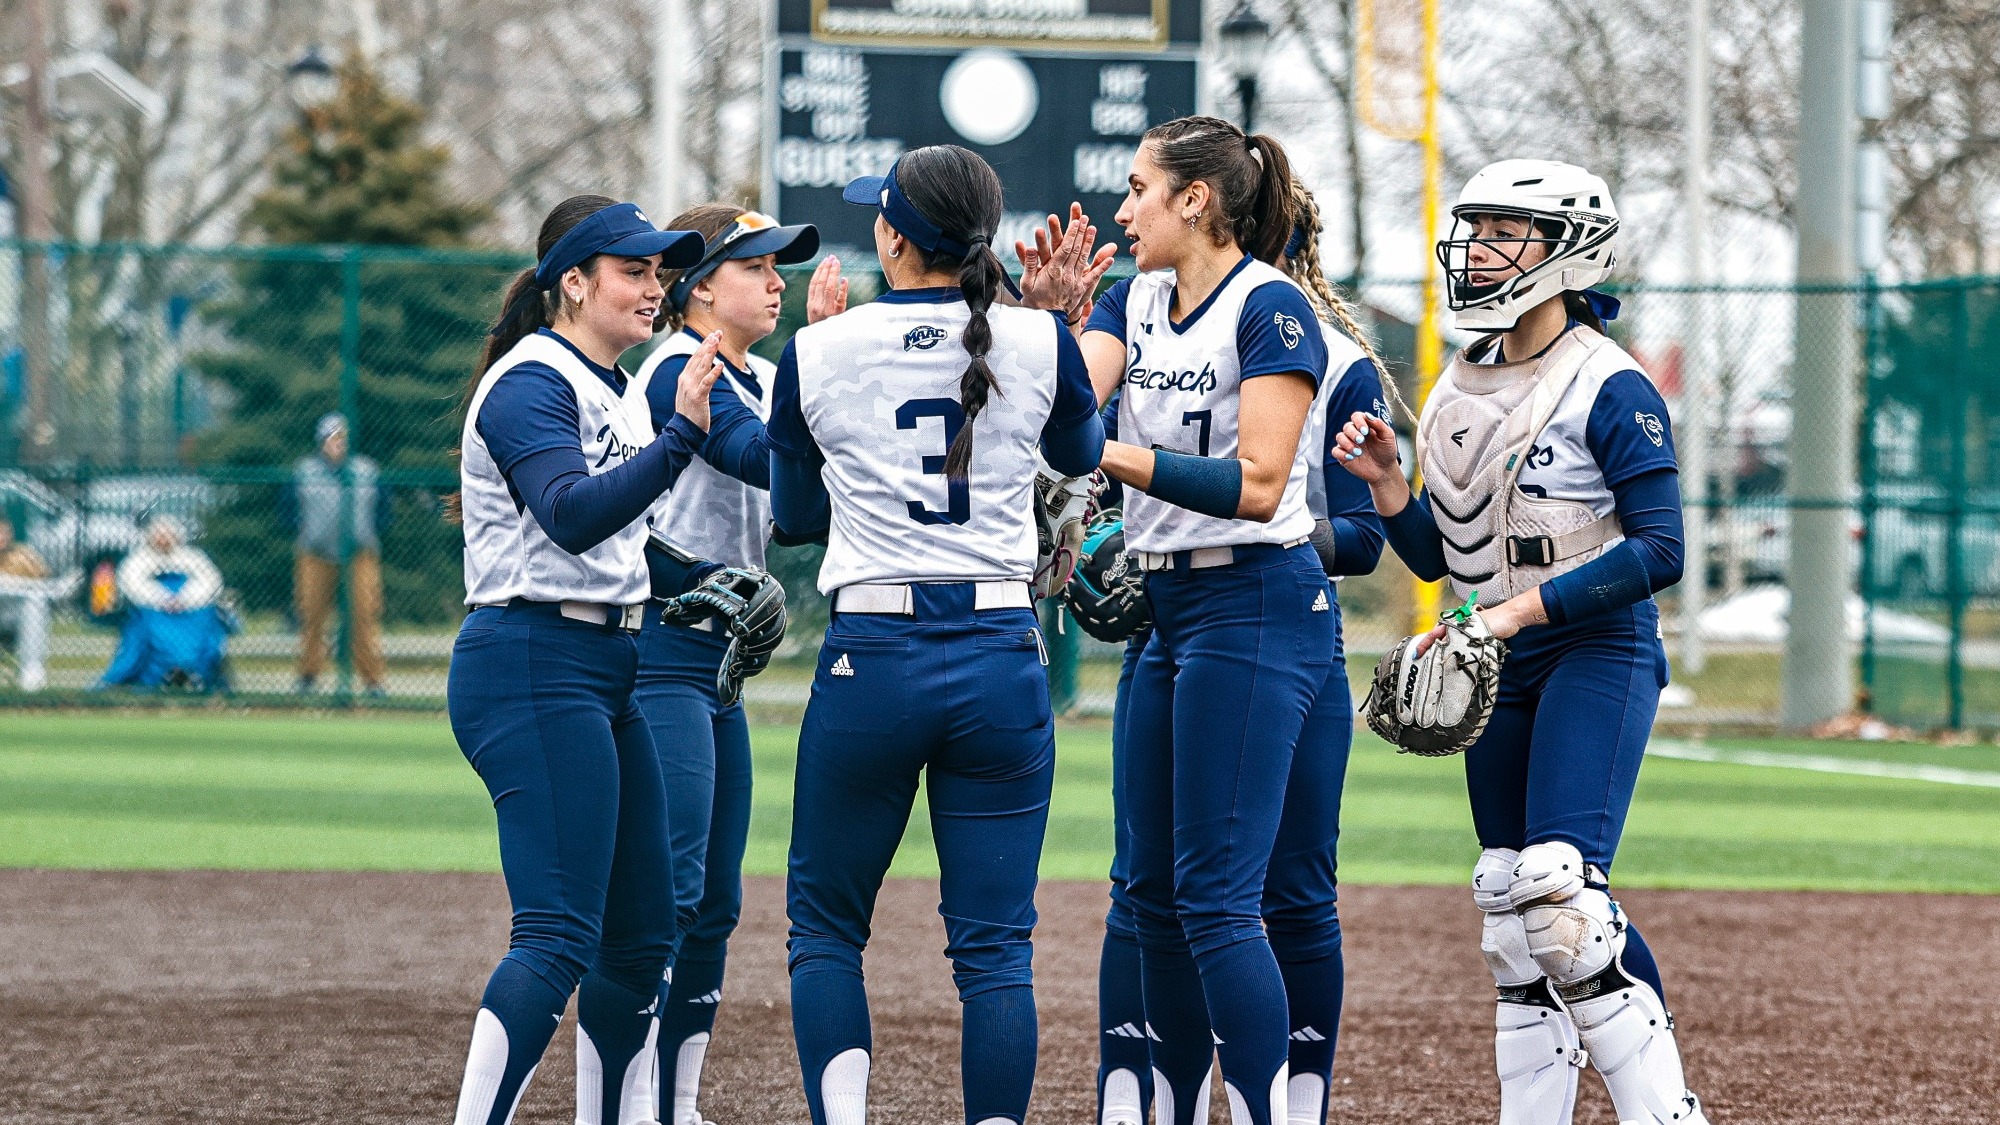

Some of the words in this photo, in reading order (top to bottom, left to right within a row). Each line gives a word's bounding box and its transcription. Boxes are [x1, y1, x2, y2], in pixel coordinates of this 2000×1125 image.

[775, 138, 902, 187] GUEST
[903, 328, 948, 352] MAAC
[1181, 409, 1212, 457] 7
[895, 398, 971, 526] 3
[830, 666, 855, 677] adidas
